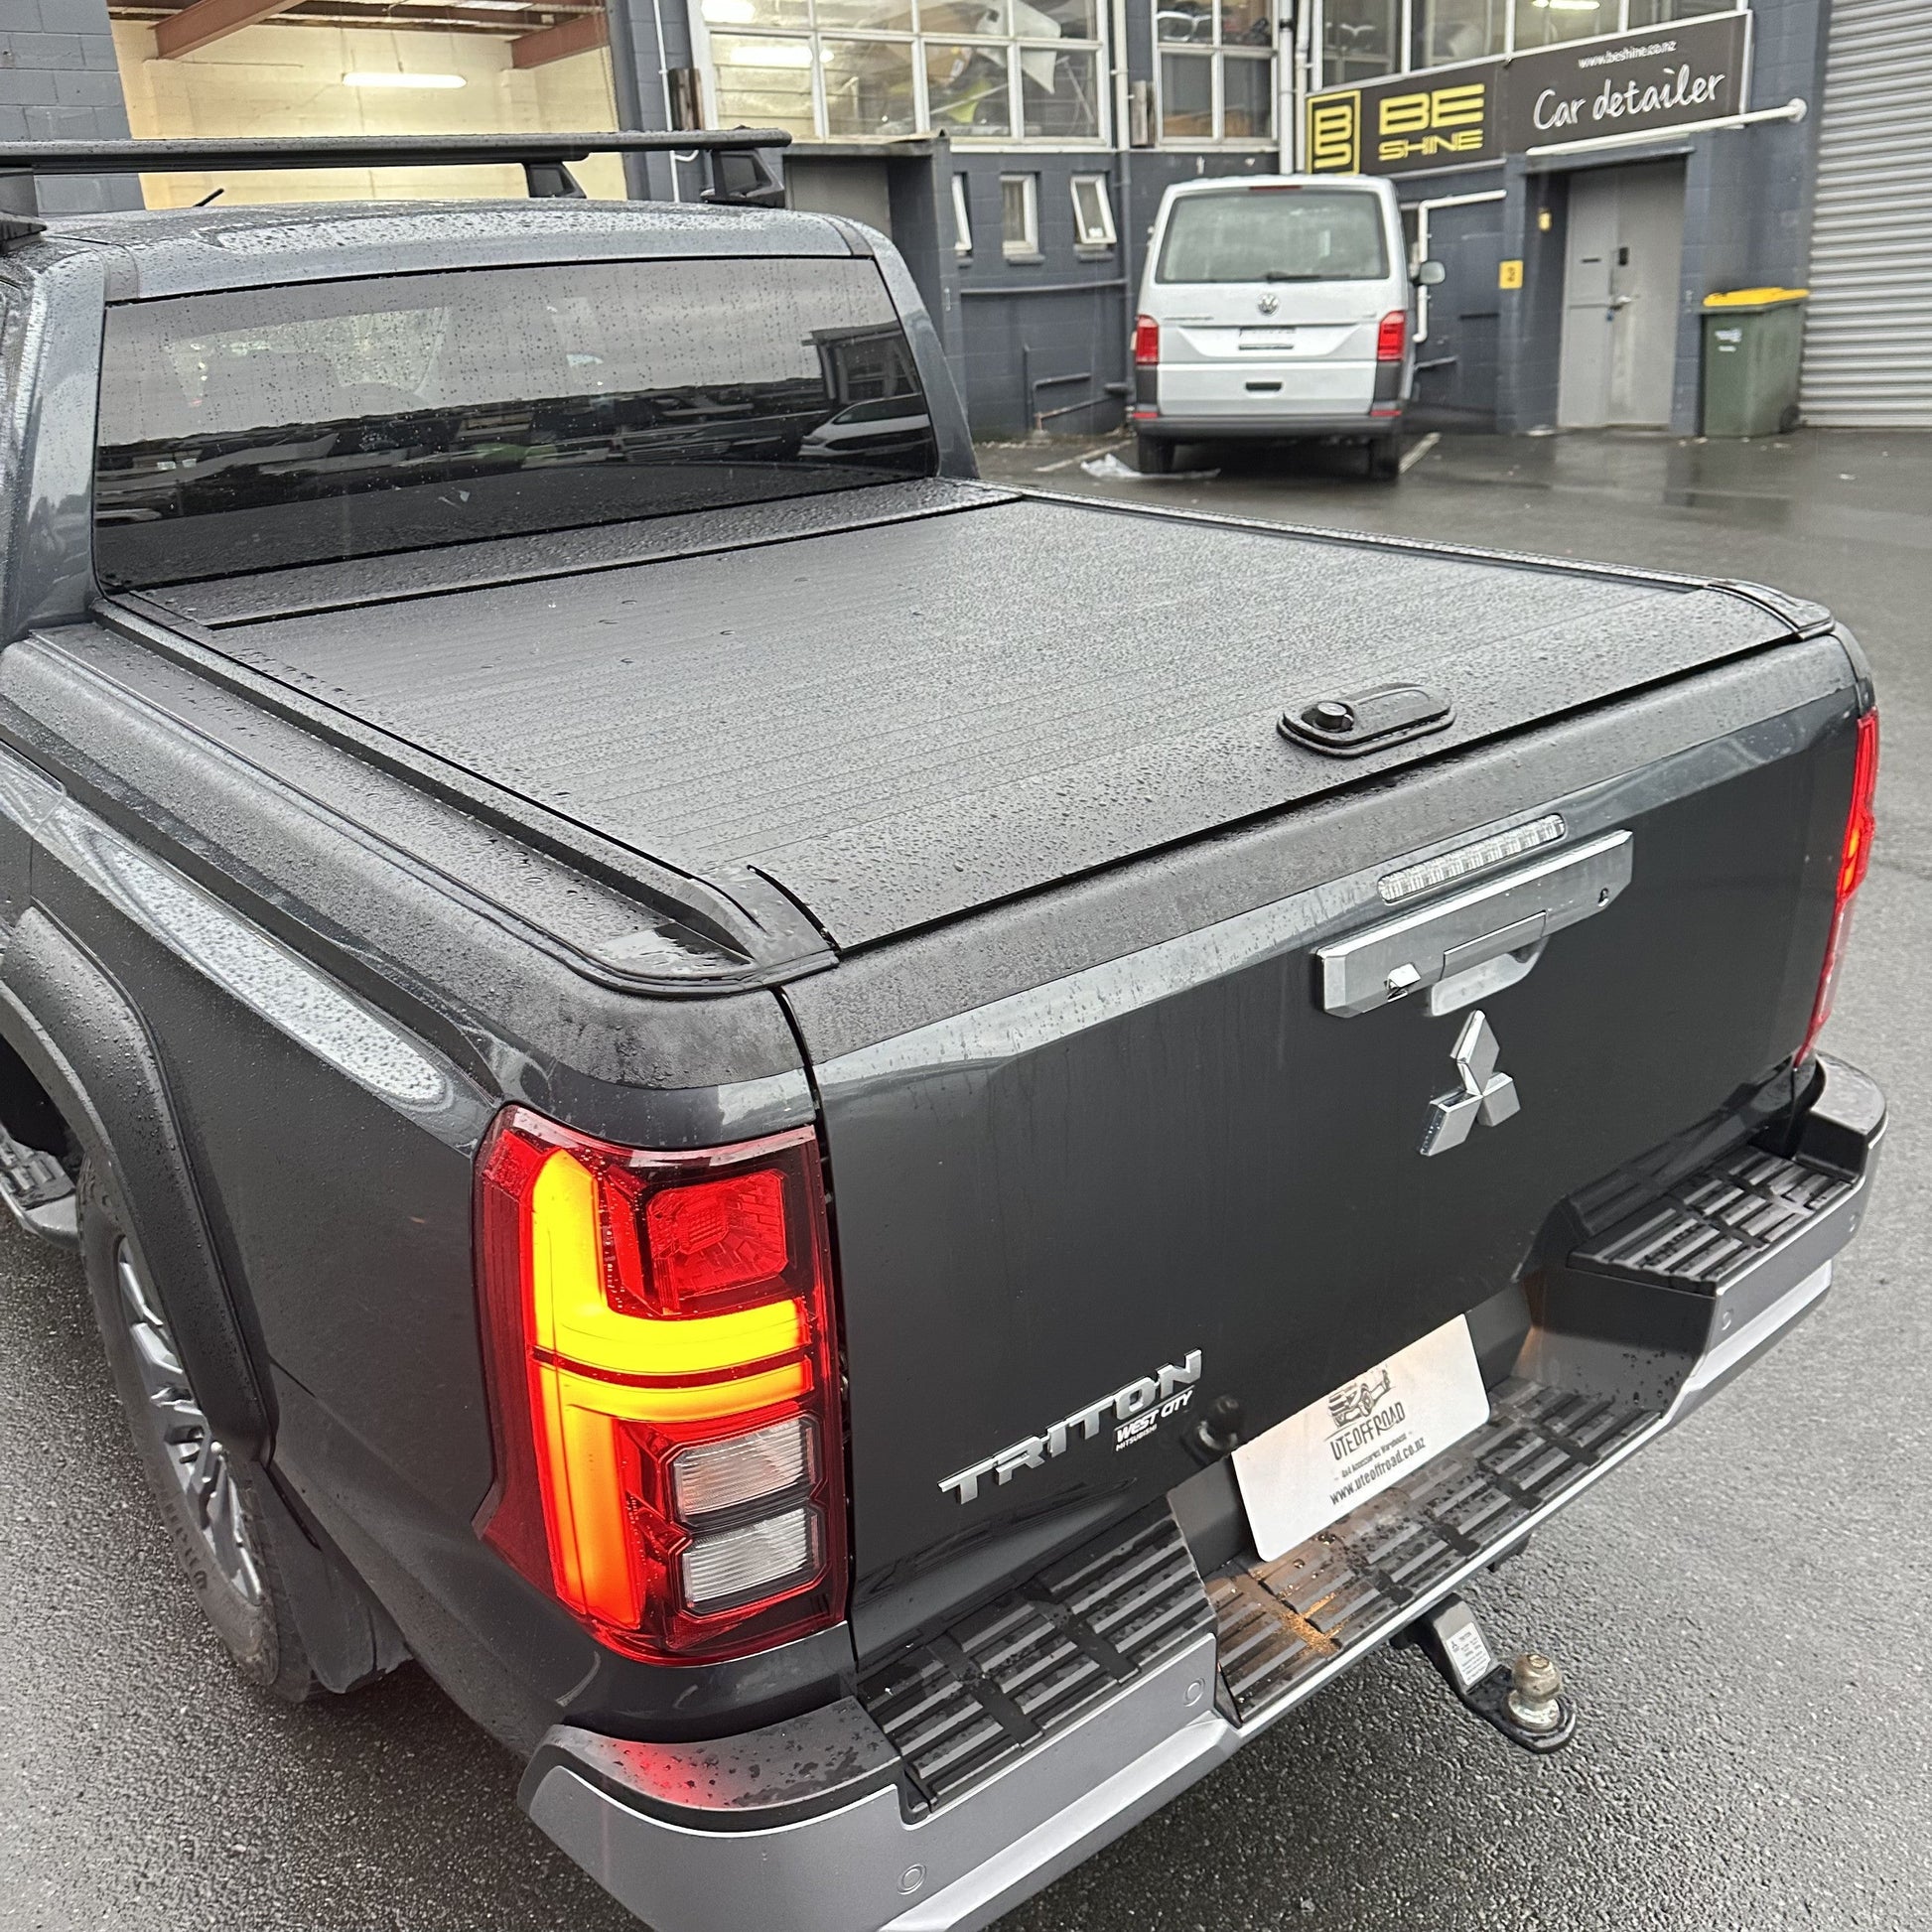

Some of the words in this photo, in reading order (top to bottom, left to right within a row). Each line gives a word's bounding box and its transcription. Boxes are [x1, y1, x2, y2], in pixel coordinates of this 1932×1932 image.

[1578, 40, 1678, 69] www.beshine.co.nz
[1378, 83, 1485, 135] BE
[1533, 87, 1587, 130] Car
[1592, 63, 1726, 121] detailer
[1377, 128, 1484, 162] SHINE
[937, 1347, 1202, 1505] TRITON
[1115, 1423, 1158, 1451] MITSUBISHI
[1117, 1409, 1160, 1444] WEST
[1160, 1390, 1193, 1419] CITY
[1329, 1401, 1407, 1461] UTEOFFROAD
[1330, 1437, 1427, 1505] www.uteoffroad.co.nz
